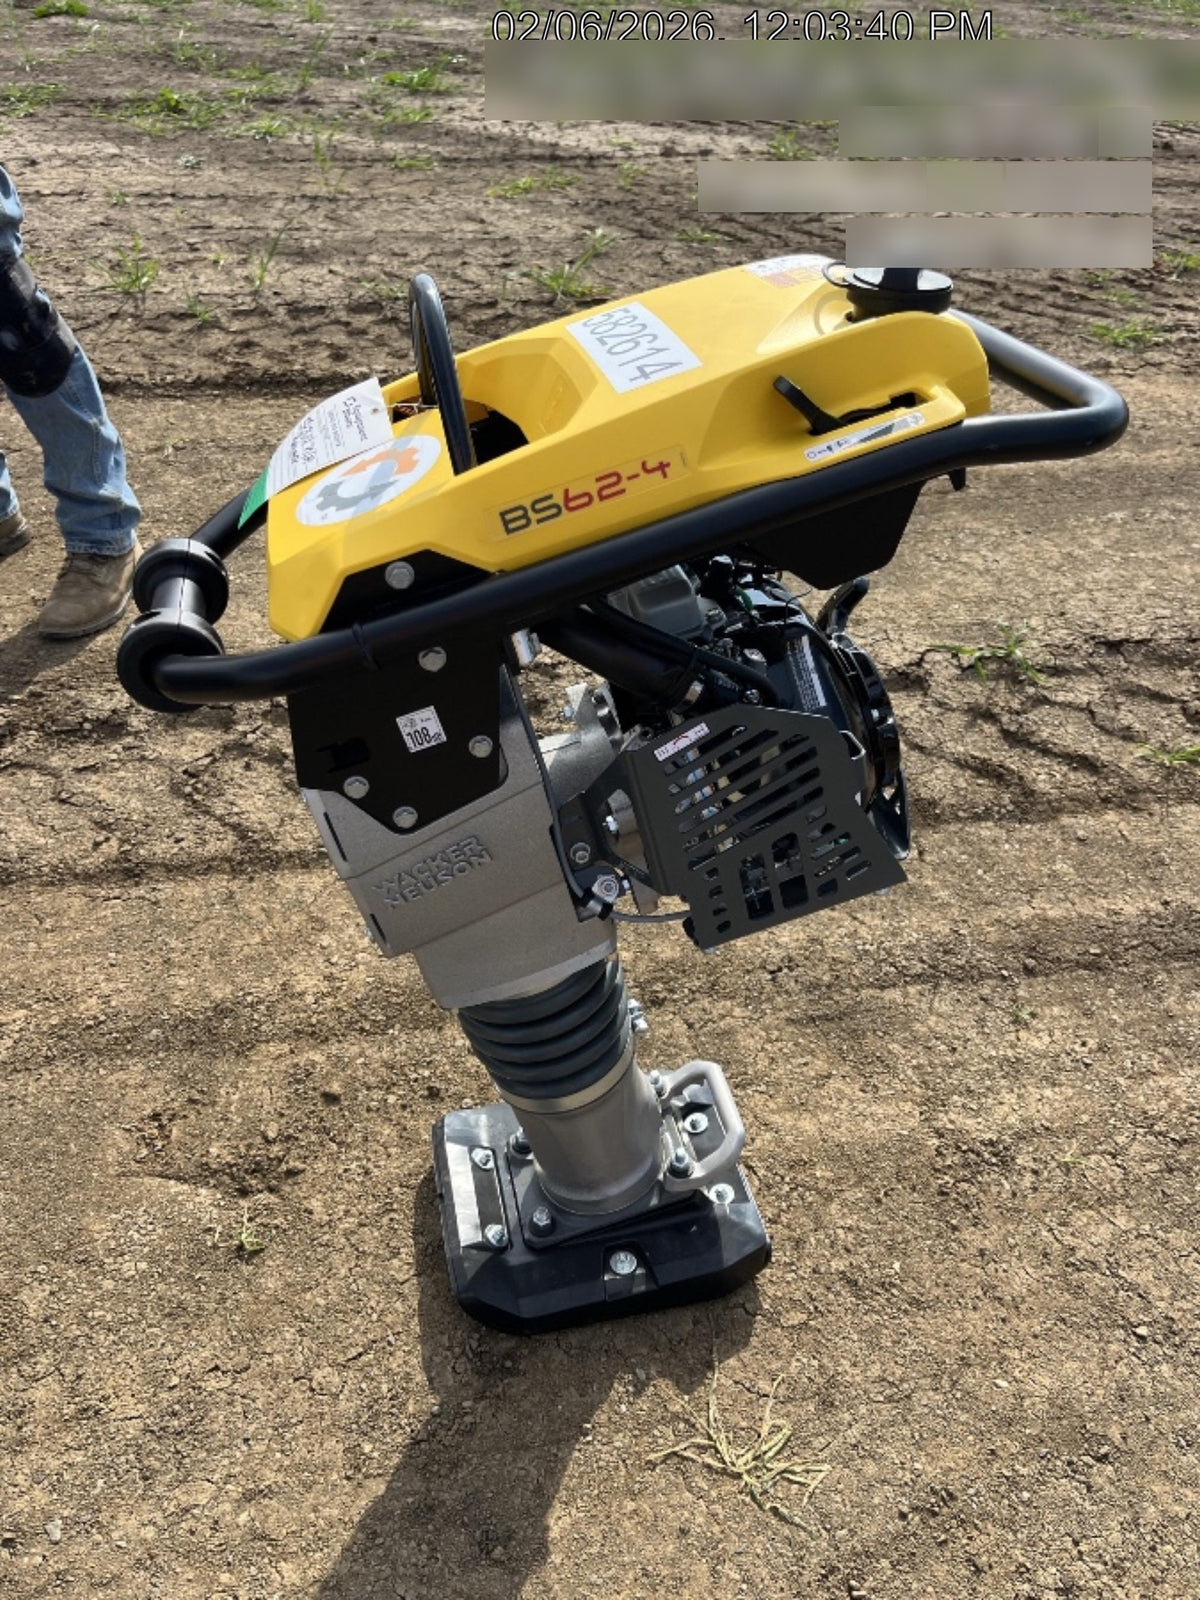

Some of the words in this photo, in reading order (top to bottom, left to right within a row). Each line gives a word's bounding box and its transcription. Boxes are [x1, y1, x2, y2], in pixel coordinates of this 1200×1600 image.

[582, 307, 683, 382] 582614
[499, 460, 671, 535] BS62-4
[371, 835, 487, 894] WACKER
[384, 847, 493, 909] NEUSON
